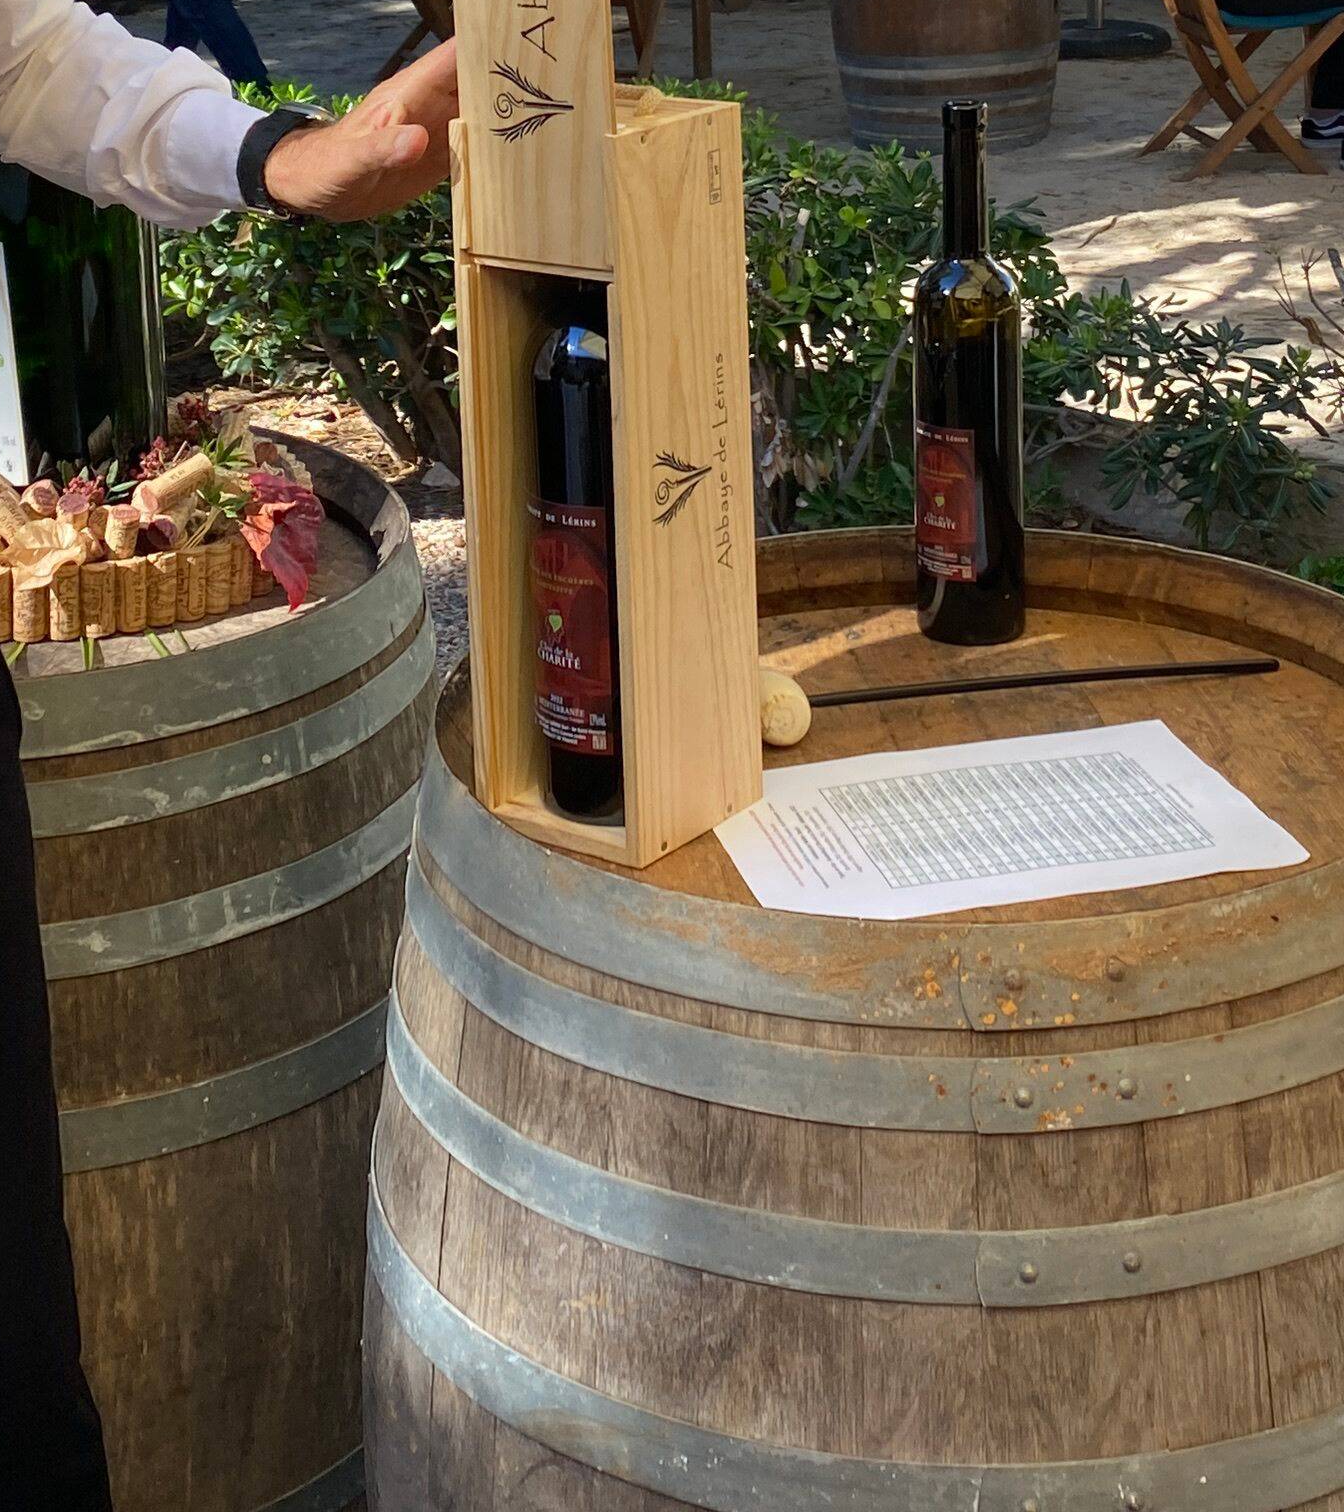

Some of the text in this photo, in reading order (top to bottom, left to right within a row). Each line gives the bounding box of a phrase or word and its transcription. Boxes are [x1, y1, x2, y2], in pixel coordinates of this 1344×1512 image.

[711, 352, 734, 569] Abbaye de Lérins
[561, 514, 597, 528] LÉRINS
[537, 646, 581, 670] CHARITÉ
